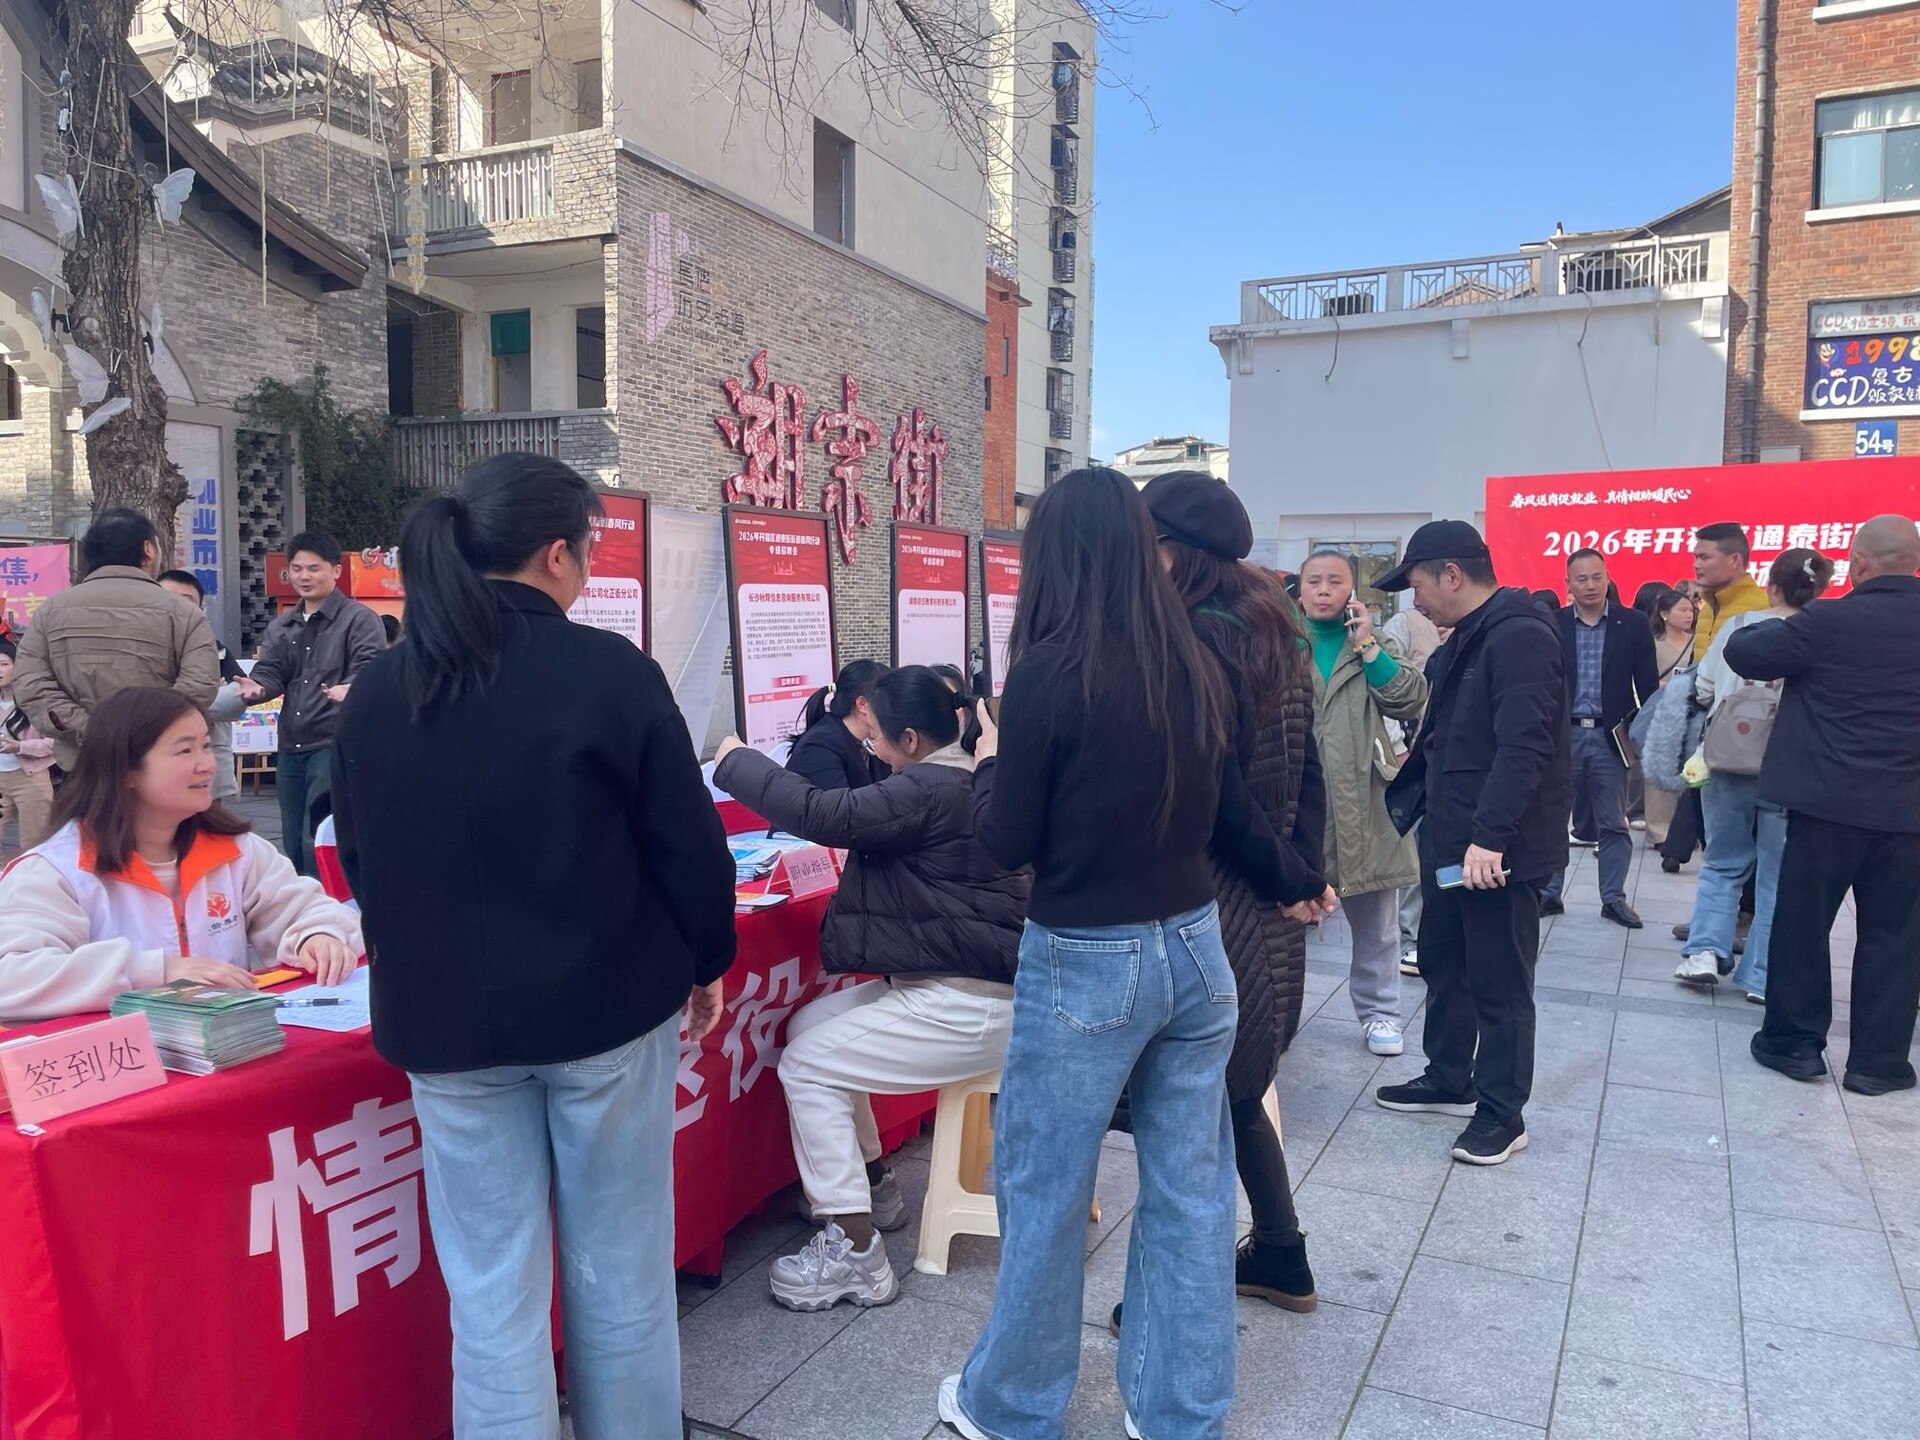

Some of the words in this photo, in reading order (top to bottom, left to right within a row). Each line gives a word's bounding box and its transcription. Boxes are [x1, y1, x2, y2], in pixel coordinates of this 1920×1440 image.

[1811, 376, 1870, 407] CCD
[1855, 429, 1894, 455] 54号
[788, 856, 832, 883] 职业指导
[24, 1037, 146, 1102] 签到处
